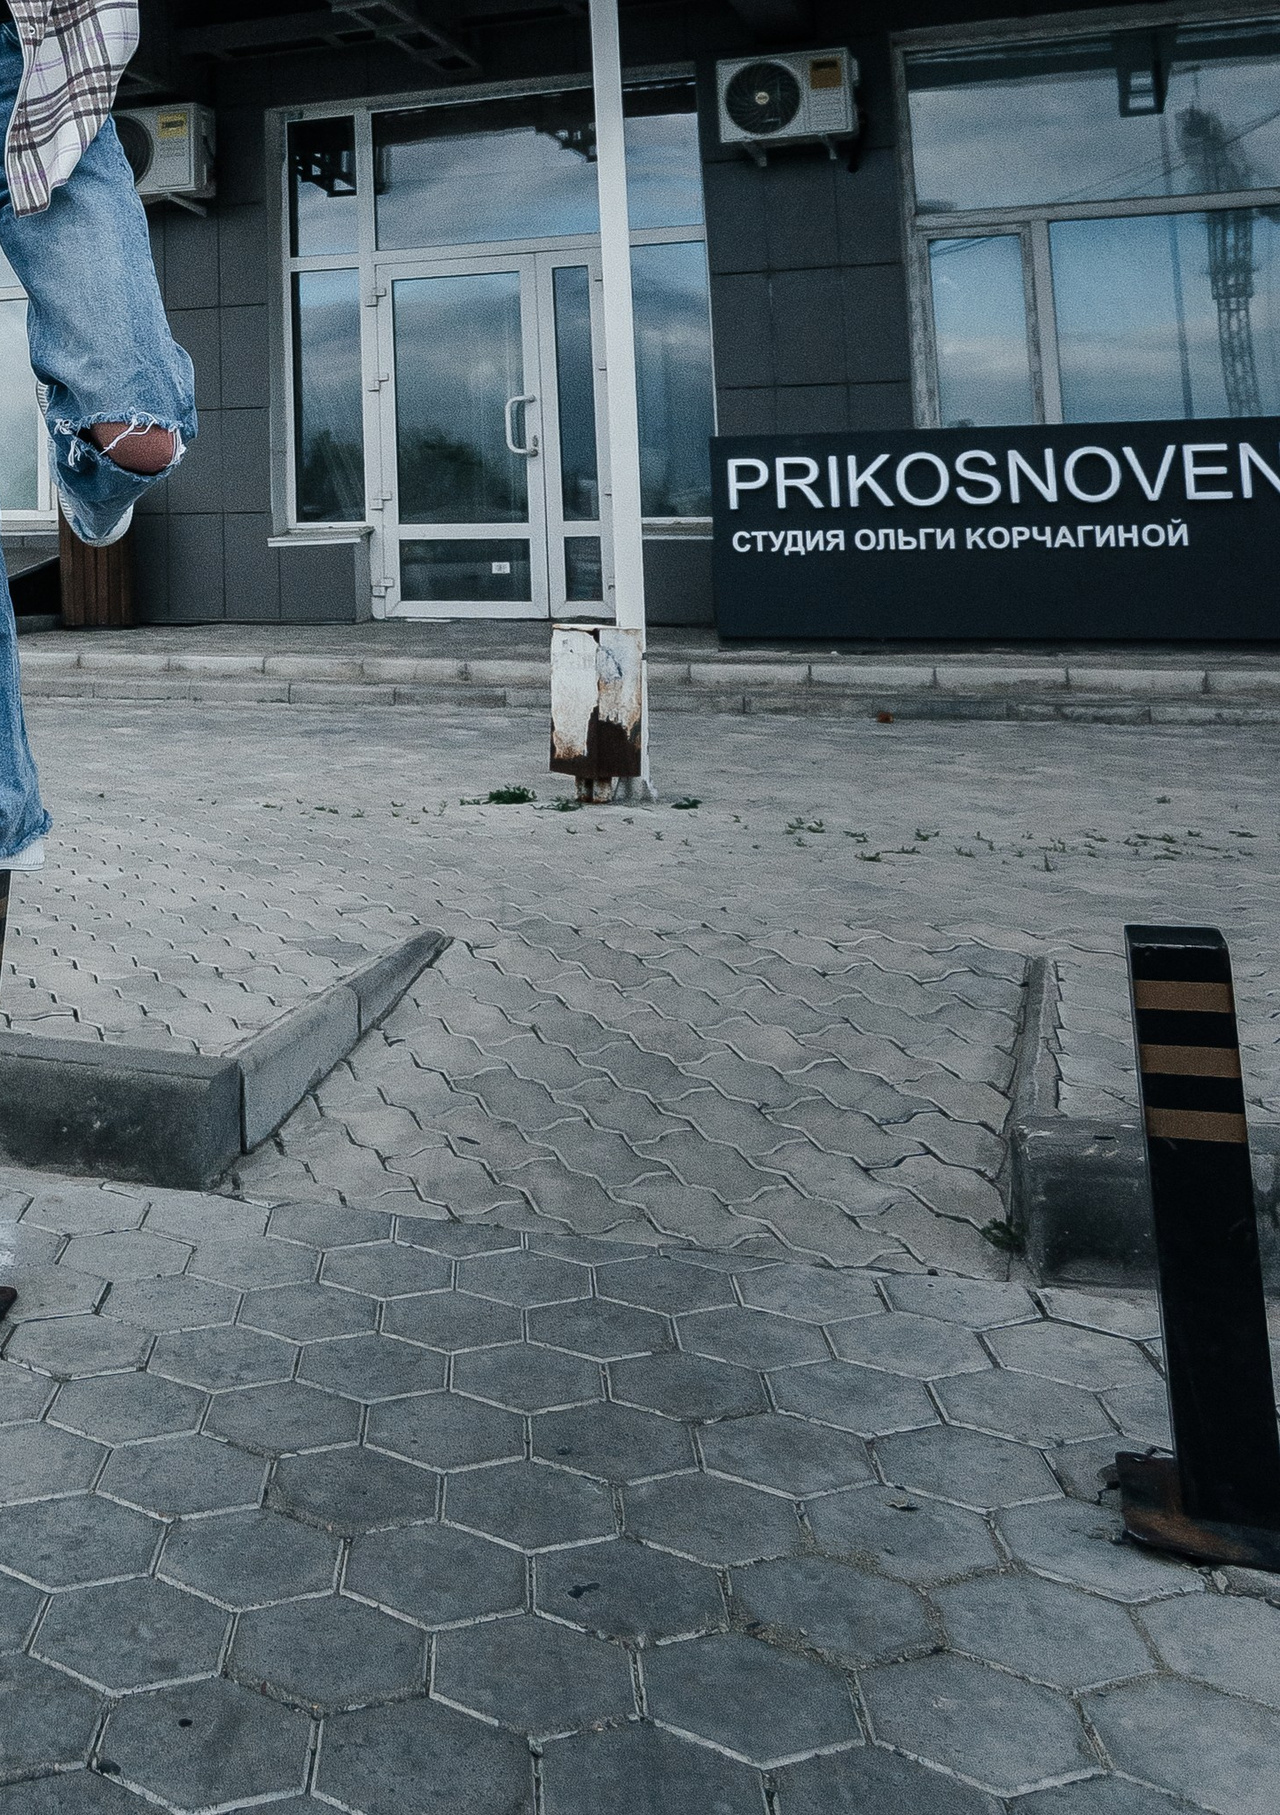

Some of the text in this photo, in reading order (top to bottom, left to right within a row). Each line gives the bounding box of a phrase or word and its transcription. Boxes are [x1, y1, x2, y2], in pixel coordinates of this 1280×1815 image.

[727, 442, 1280, 510] PRIKOSNOVEN
[732, 518, 1190, 556] СТУДИЯ ОЛЬГИ КОРЧАГИНОЙ
